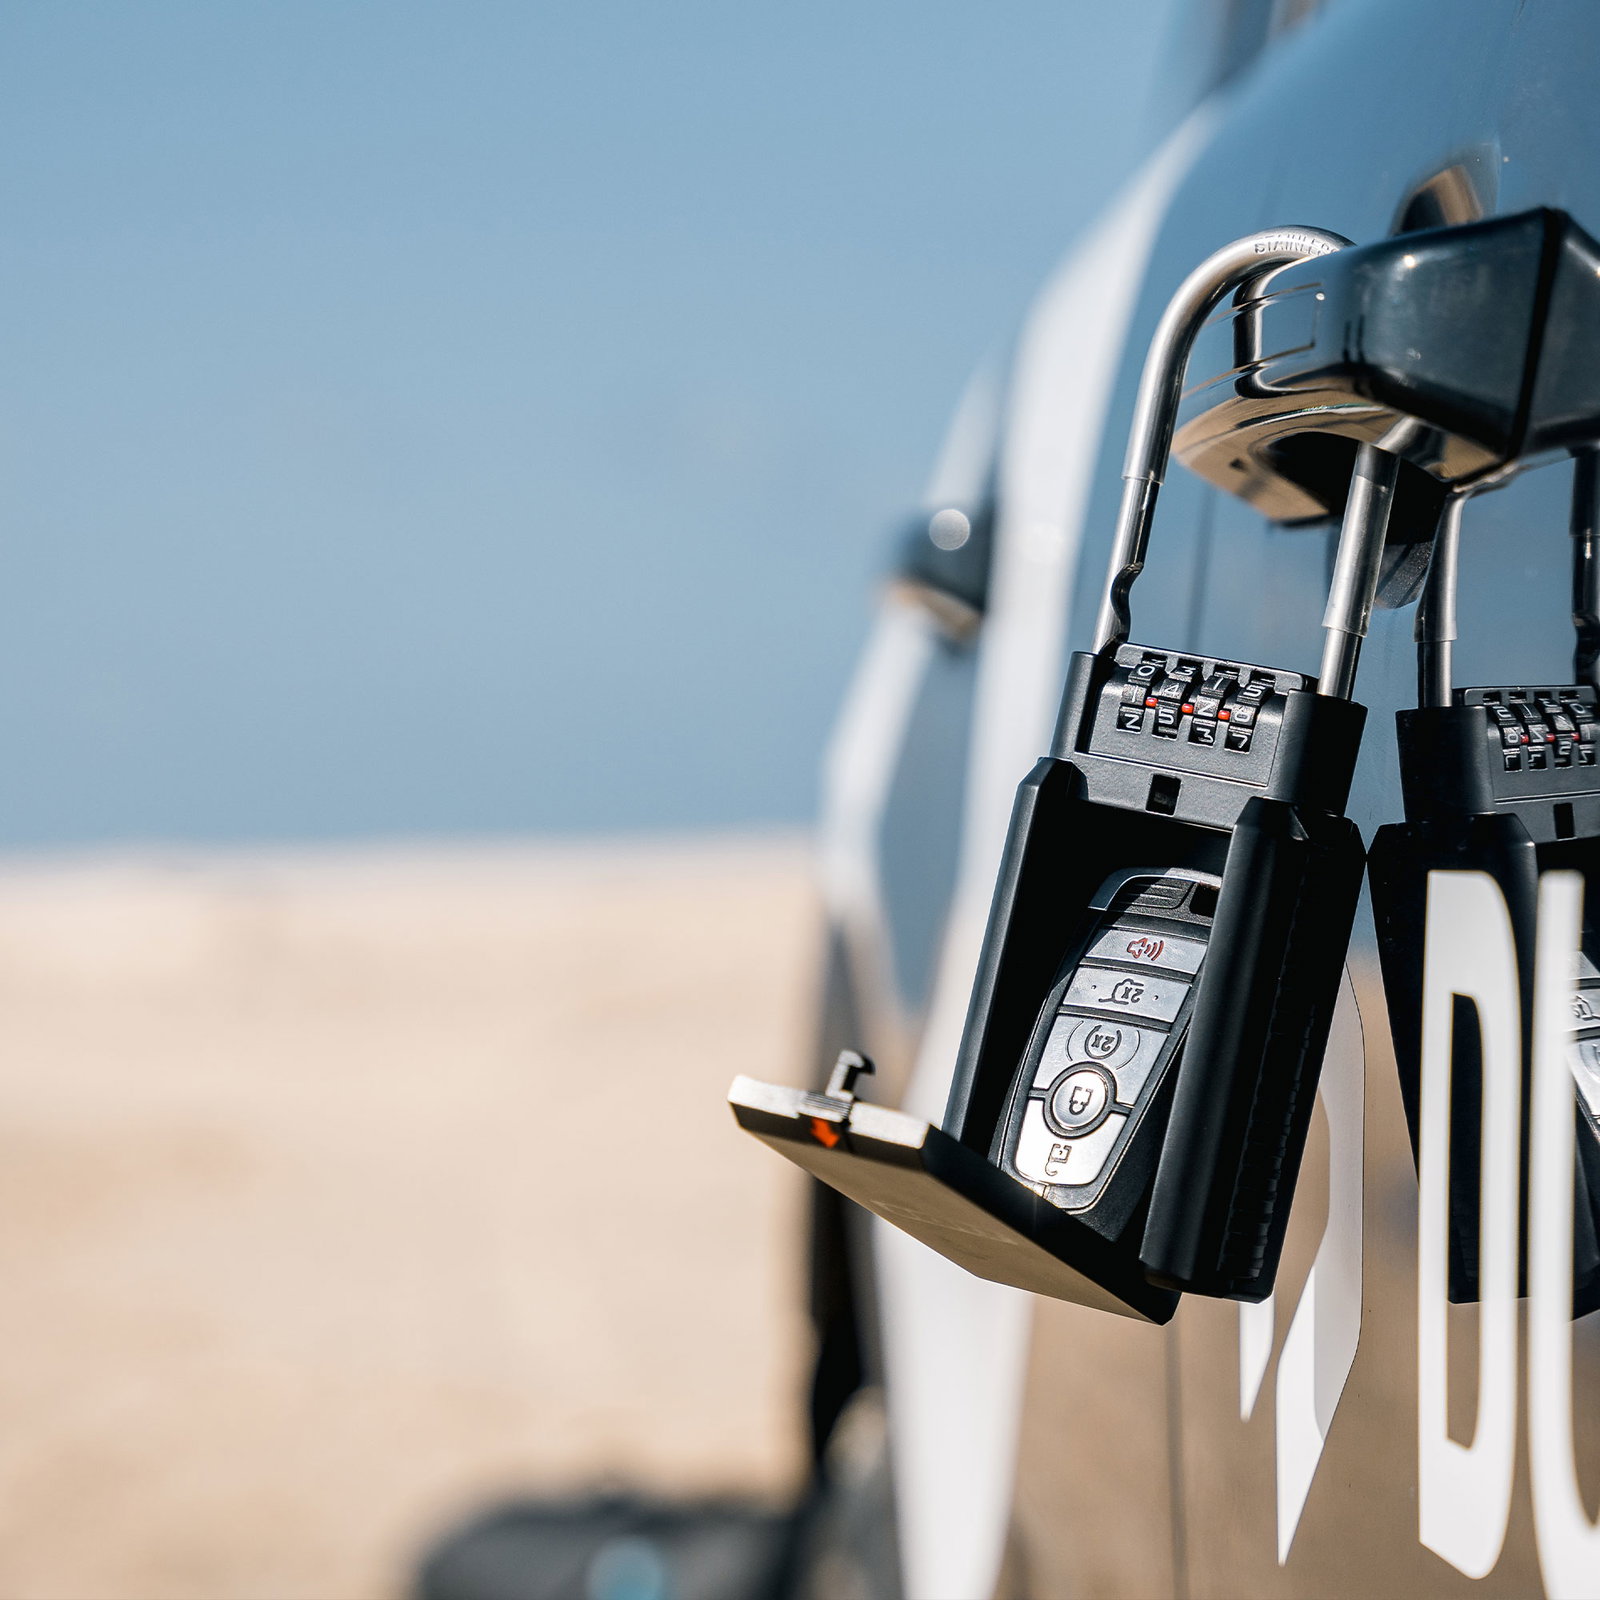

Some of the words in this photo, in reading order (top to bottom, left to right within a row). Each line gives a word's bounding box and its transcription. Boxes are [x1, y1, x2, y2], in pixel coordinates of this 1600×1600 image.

[1137, 665, 1156, 677] 0
[1243, 684, 1266, 698] 5
[1131, 686, 1139, 703] 1
[1164, 682, 1180, 698] 4
[1197, 700, 1218, 717] 2
[1234, 706, 1251, 723] 6
[1124, 713, 1141, 730] 2
[1158, 708, 1175, 725] 5
[1196, 727, 1214, 743] 3
[1232, 733, 1248, 749] 7
